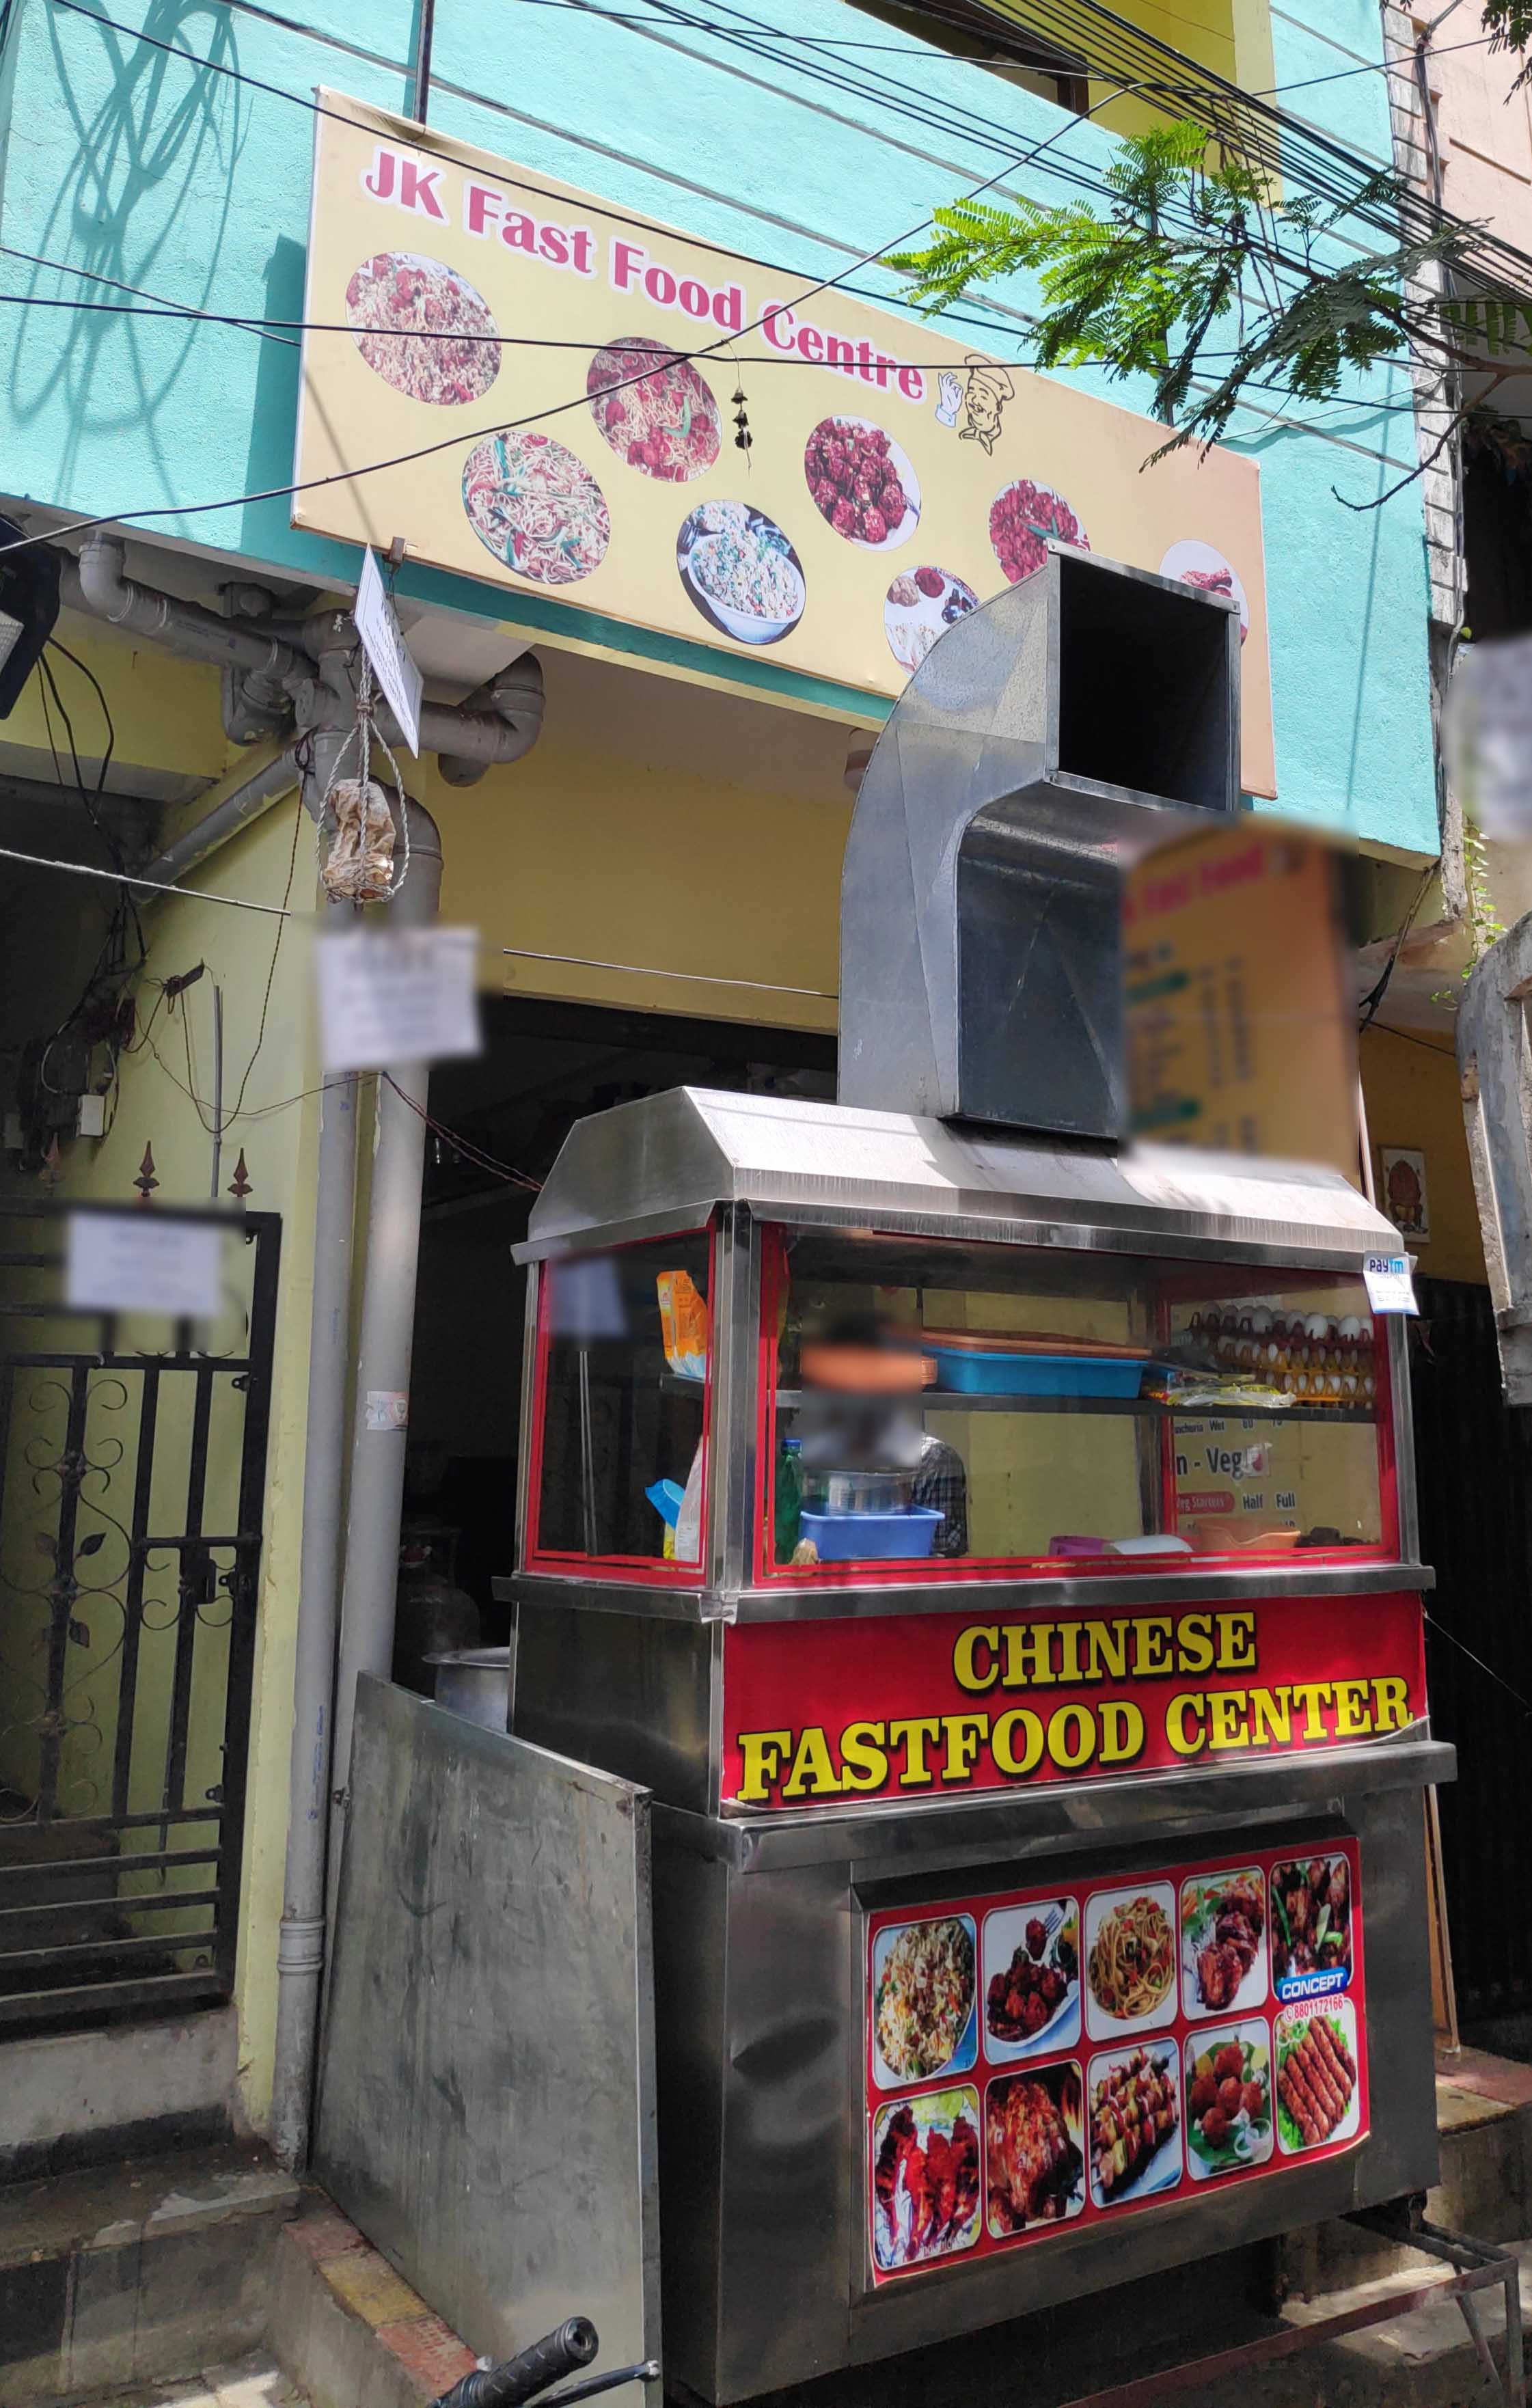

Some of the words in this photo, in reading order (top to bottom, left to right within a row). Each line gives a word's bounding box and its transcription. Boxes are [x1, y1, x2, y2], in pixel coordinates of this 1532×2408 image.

[366, 151, 446, 221] JK
[467, 185, 593, 274] Fast
[614, 242, 743, 332] Food
[762, 304, 923, 400] Centre
[1206, 1447, 1244, 1480] Veg
[1243, 1494, 1263, 1509] Half
[1276, 1492, 1296, 1508] Full
[953, 1612, 1257, 1691] CHINESE
[737, 1701, 1145, 1801] FASTFOOD
[1165, 1676, 1414, 1755] CENTER
[1281, 1972, 1344, 2000] CONCEPT
